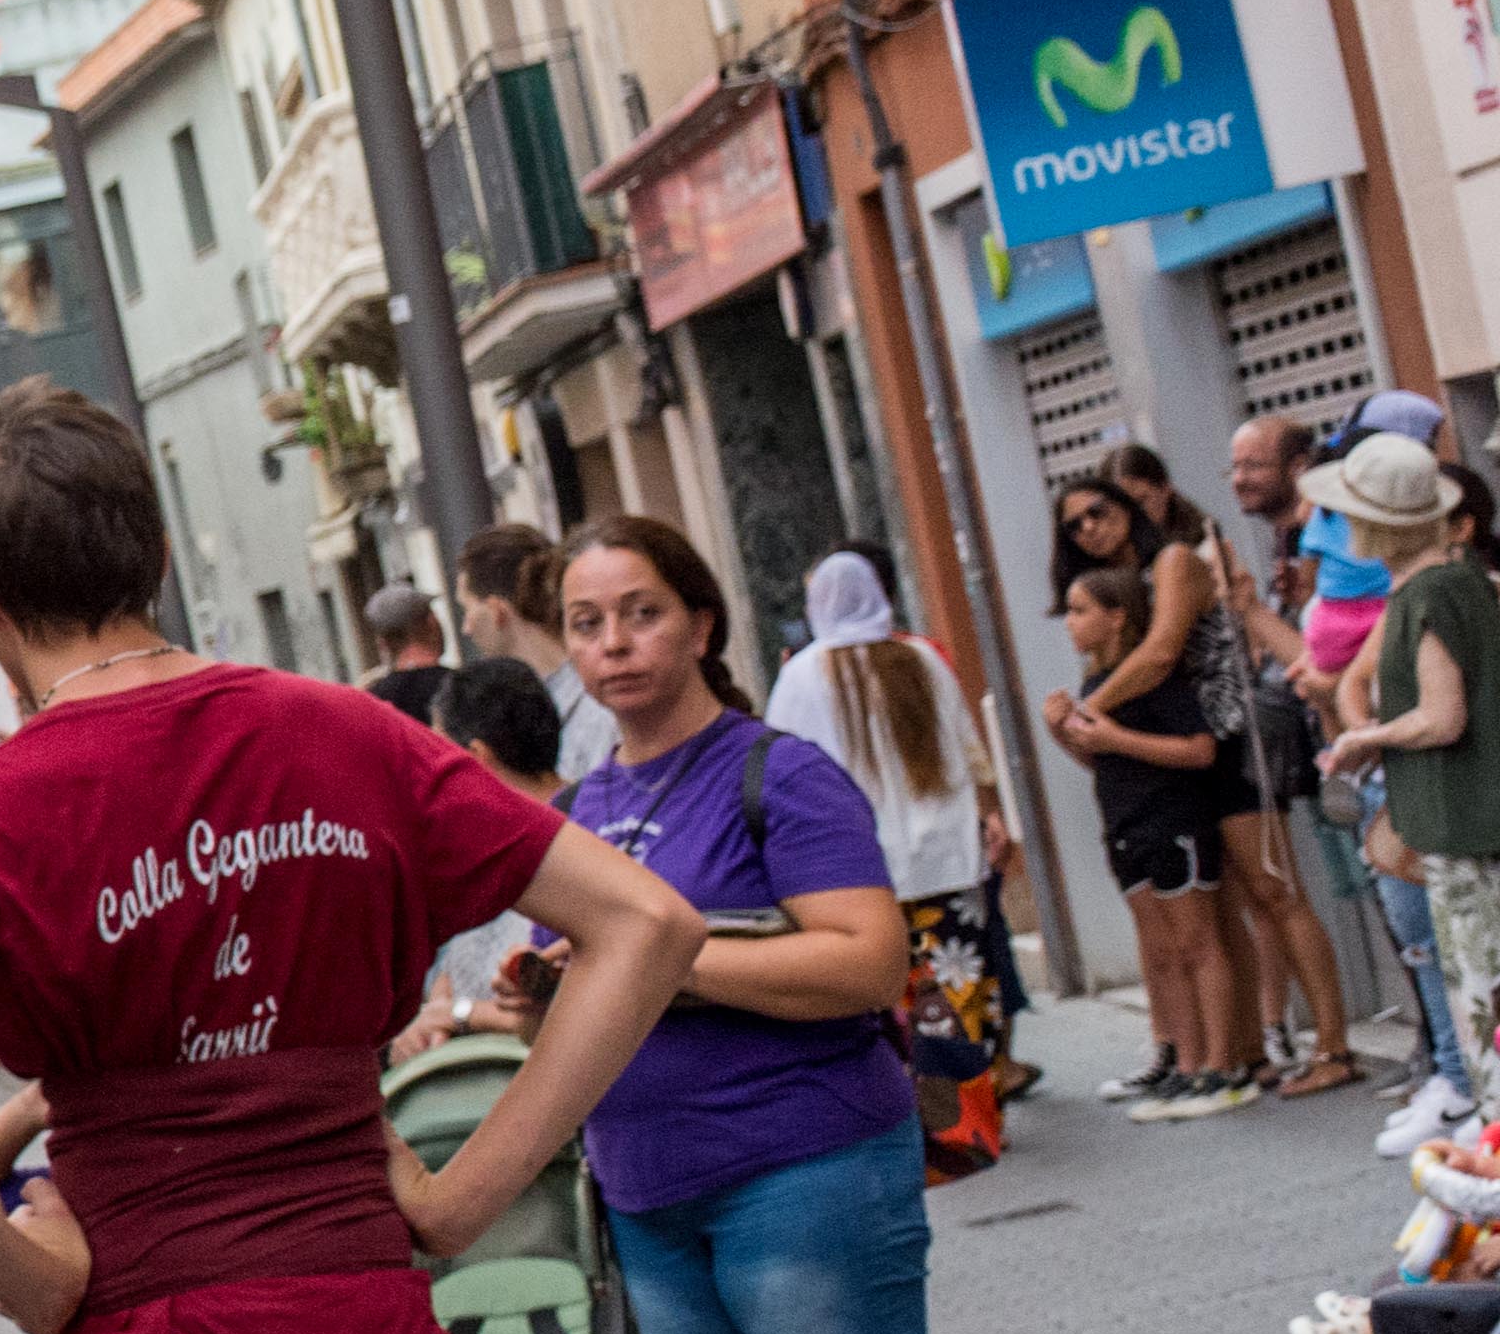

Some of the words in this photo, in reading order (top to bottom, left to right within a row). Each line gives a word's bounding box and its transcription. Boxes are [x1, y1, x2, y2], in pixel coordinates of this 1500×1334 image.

[1012, 112, 1235, 195] movistar
[97, 846, 186, 944] Colla
[186, 807, 370, 905] Gegantera
[213, 914, 252, 982] de
